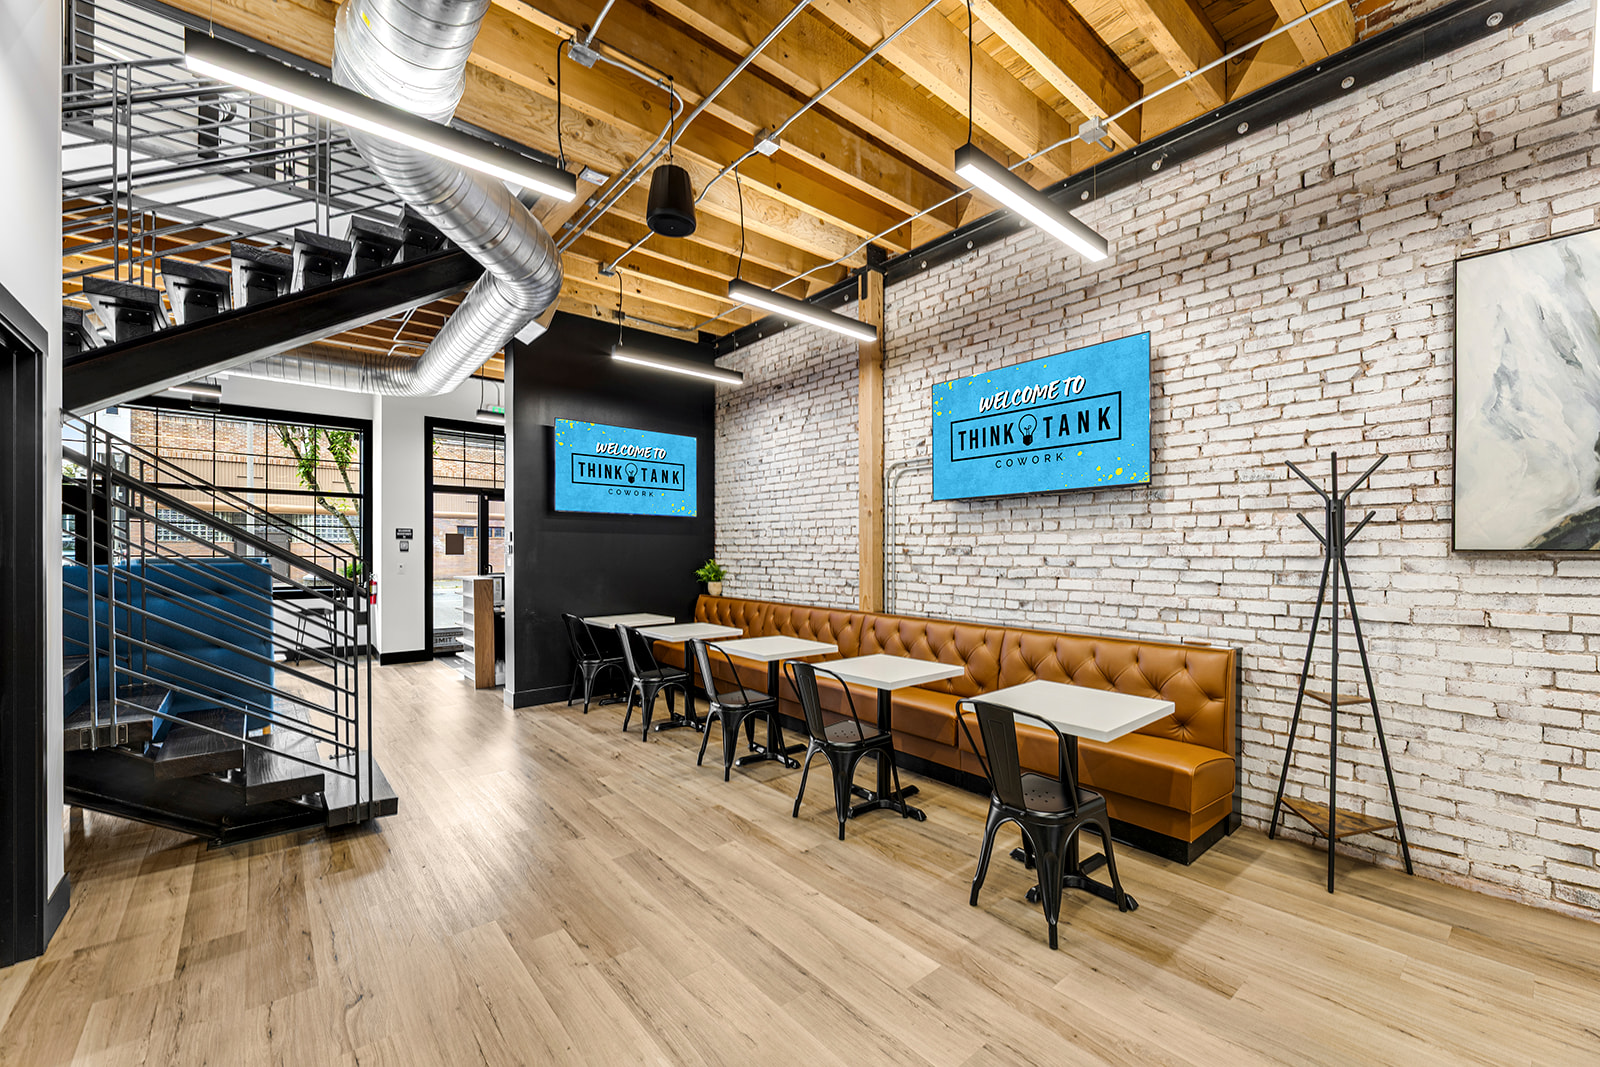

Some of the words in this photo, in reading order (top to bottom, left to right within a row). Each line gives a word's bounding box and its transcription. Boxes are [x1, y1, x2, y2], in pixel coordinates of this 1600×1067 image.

[979, 379, 1061, 413] WELCOME
[1062, 375, 1087, 395] TO
[957, 422, 1015, 451] THINK
[1042, 406, 1112, 439] TANK
[595, 441, 652, 459] WELCOME
[653, 447, 667, 460] TO
[994, 452, 1065, 468] COWORK
[578, 461, 622, 480] THINK
[641, 467, 680, 484] TANK
[608, 488, 654, 498] COWORK
